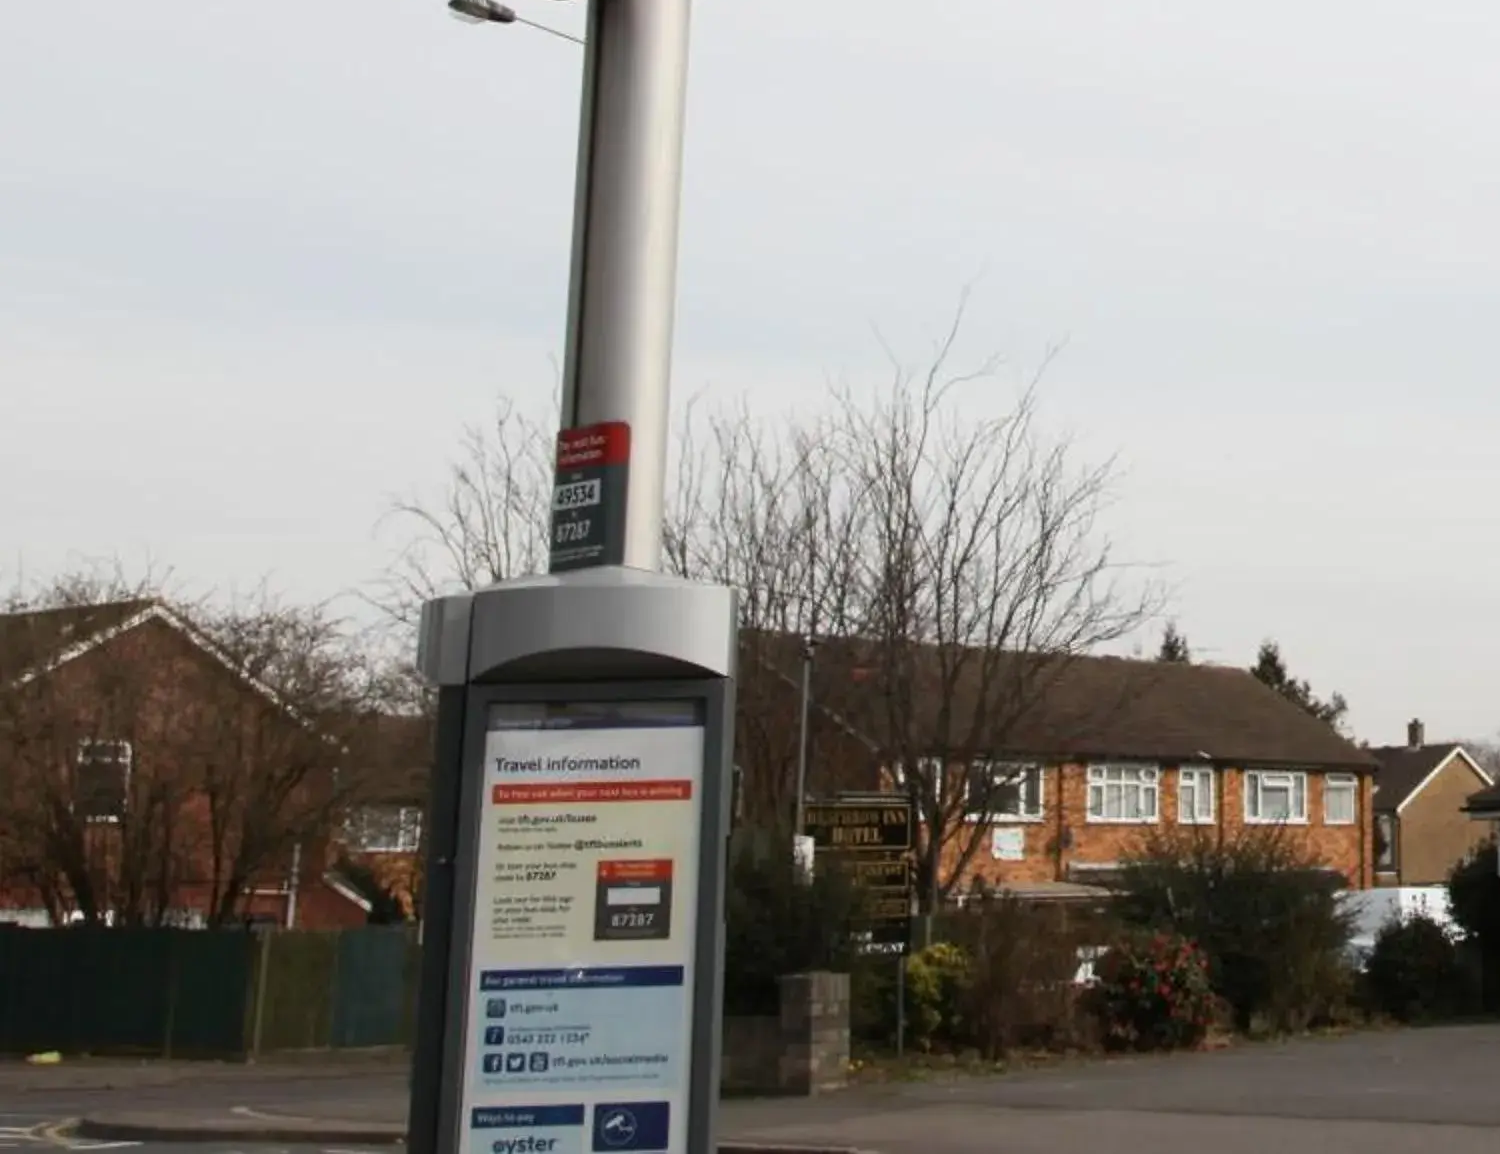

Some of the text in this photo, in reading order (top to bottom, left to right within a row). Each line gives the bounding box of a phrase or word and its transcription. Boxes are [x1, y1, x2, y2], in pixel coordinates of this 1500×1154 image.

[496, 754, 641, 773] Travel information
[611, 912, 654, 927] 87287
[492, 1134, 558, 1154] oyster
